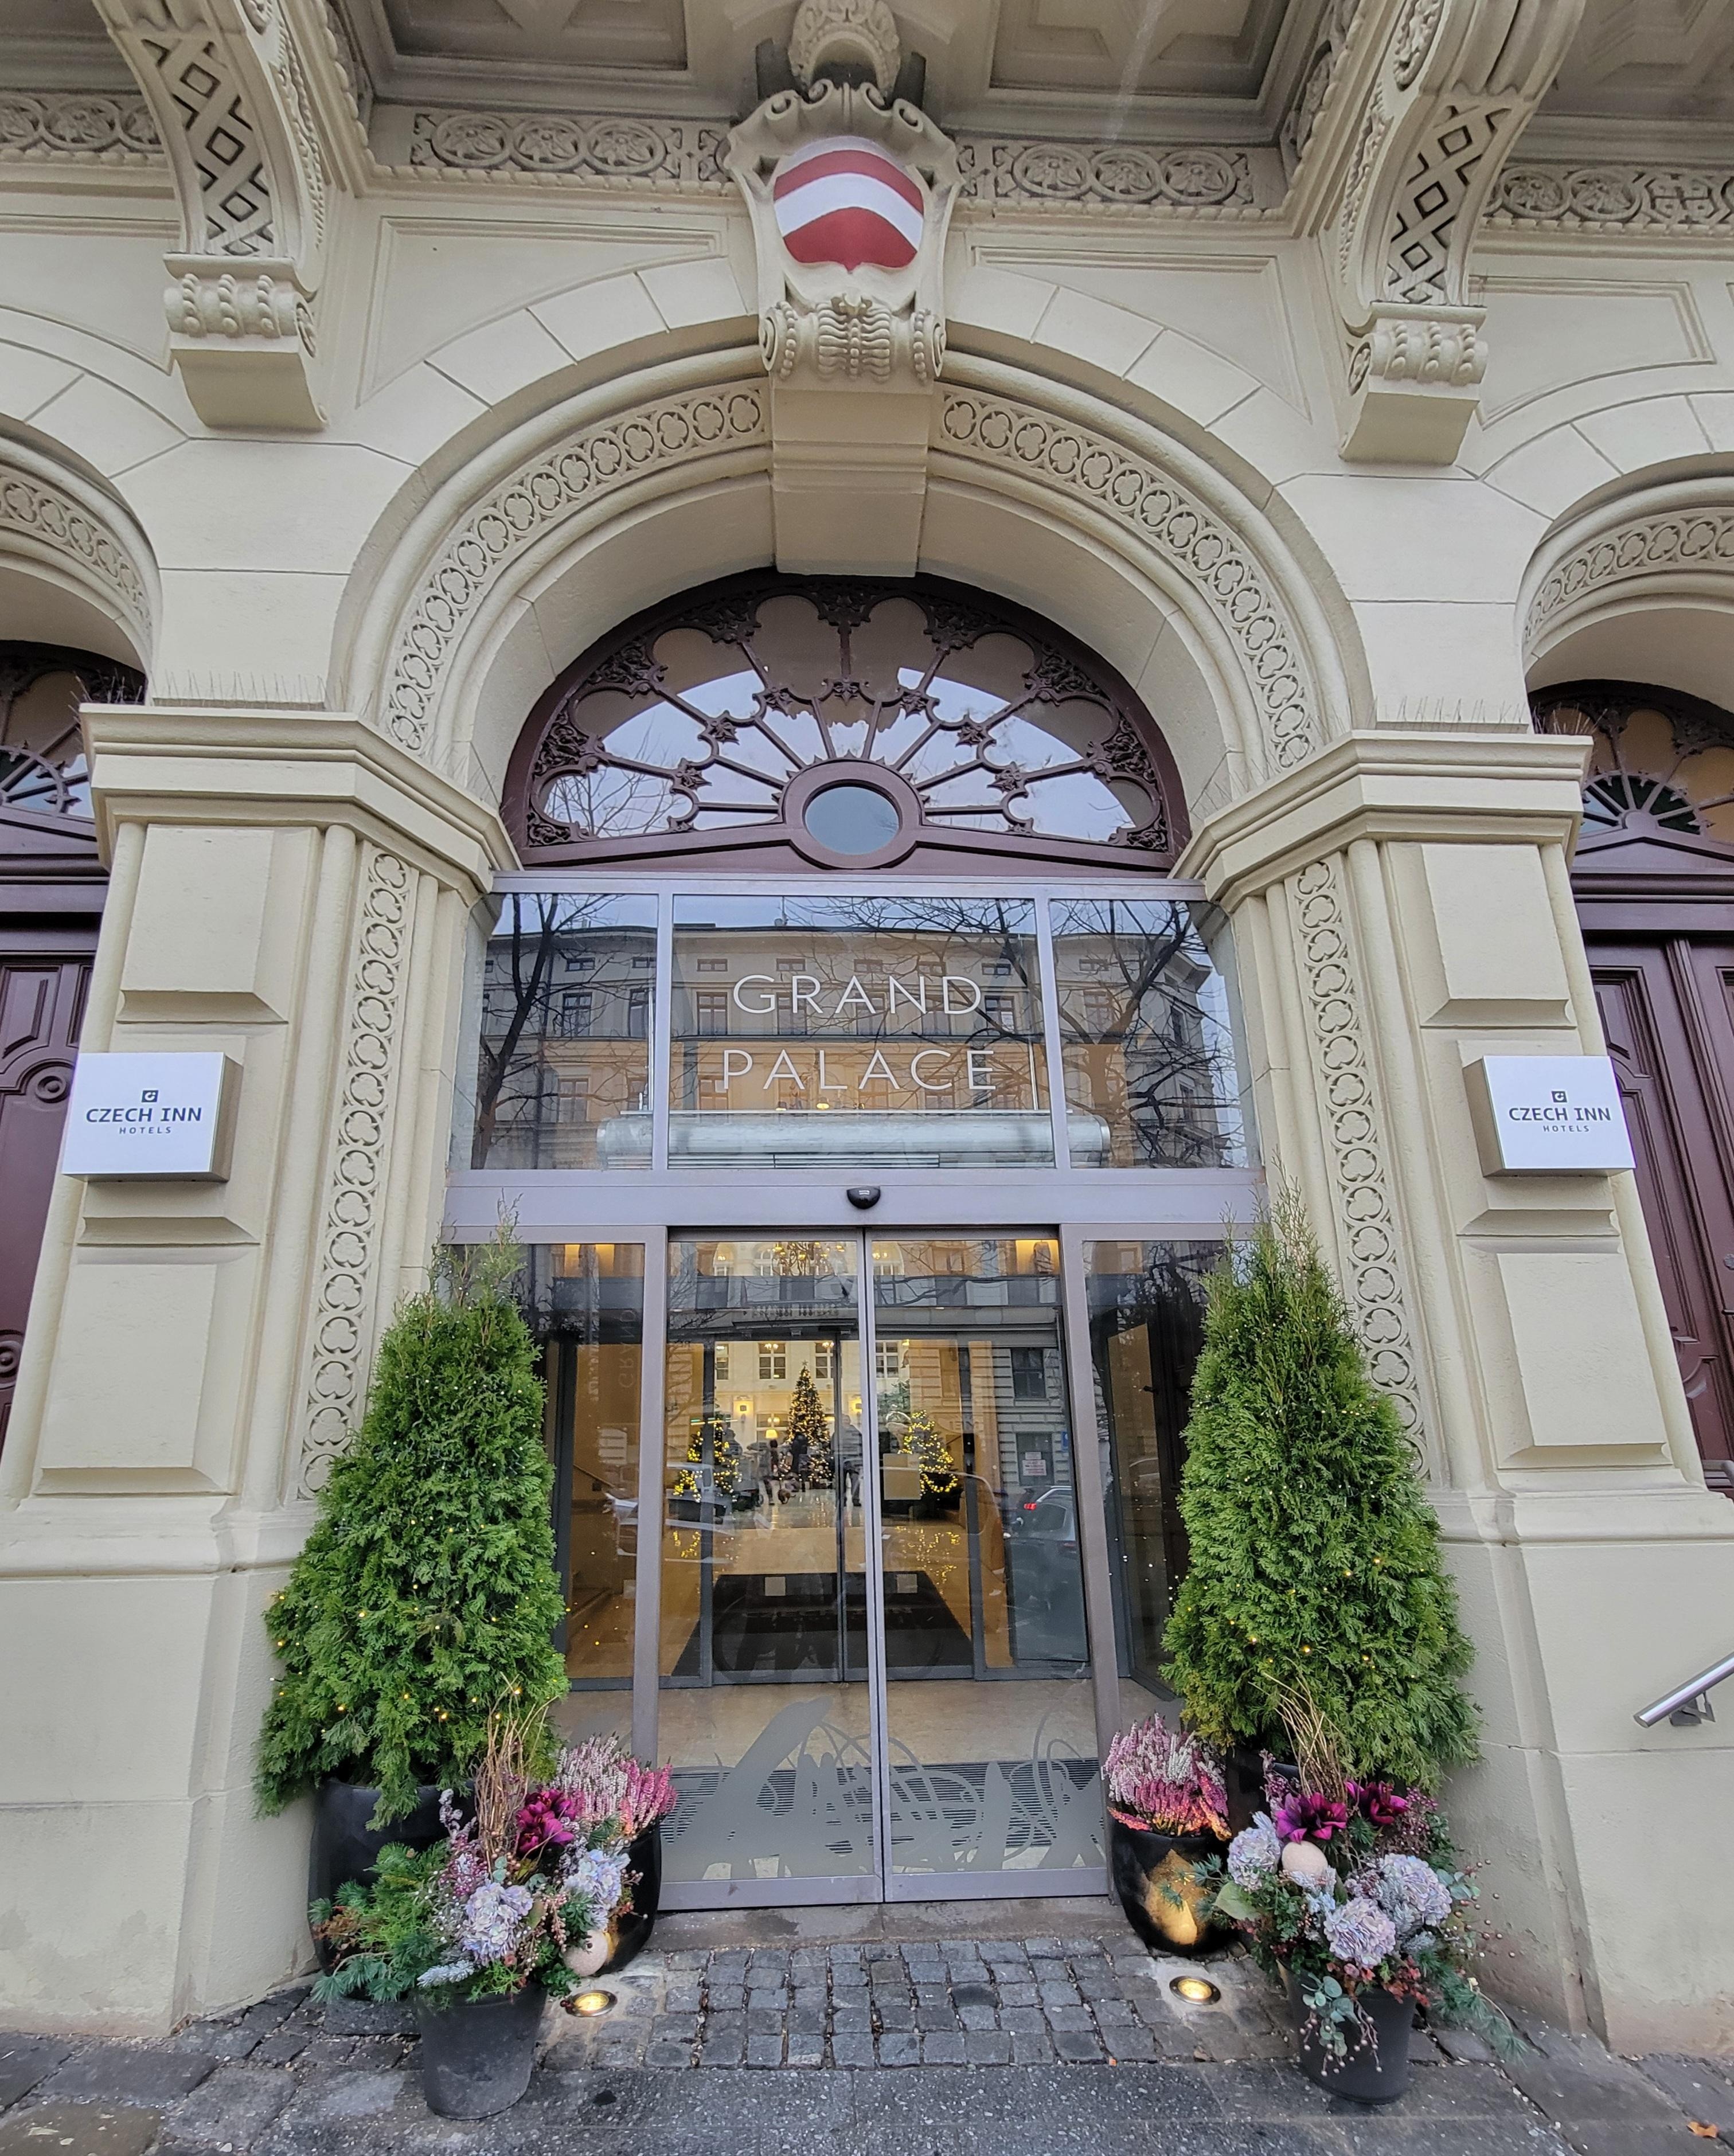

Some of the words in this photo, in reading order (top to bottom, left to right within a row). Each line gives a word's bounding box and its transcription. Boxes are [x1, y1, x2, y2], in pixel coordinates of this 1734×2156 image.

[733, 974, 982, 1015] GRAND
[723, 1049, 997, 1090] PALACE
[85, 1107, 153, 1123] CZECH
[160, 1107, 202, 1122] INN
[1509, 1107, 1568, 1121] CZECH
[1573, 1107, 1611, 1121] INN
[119, 1126, 171, 1134] HOTELS
